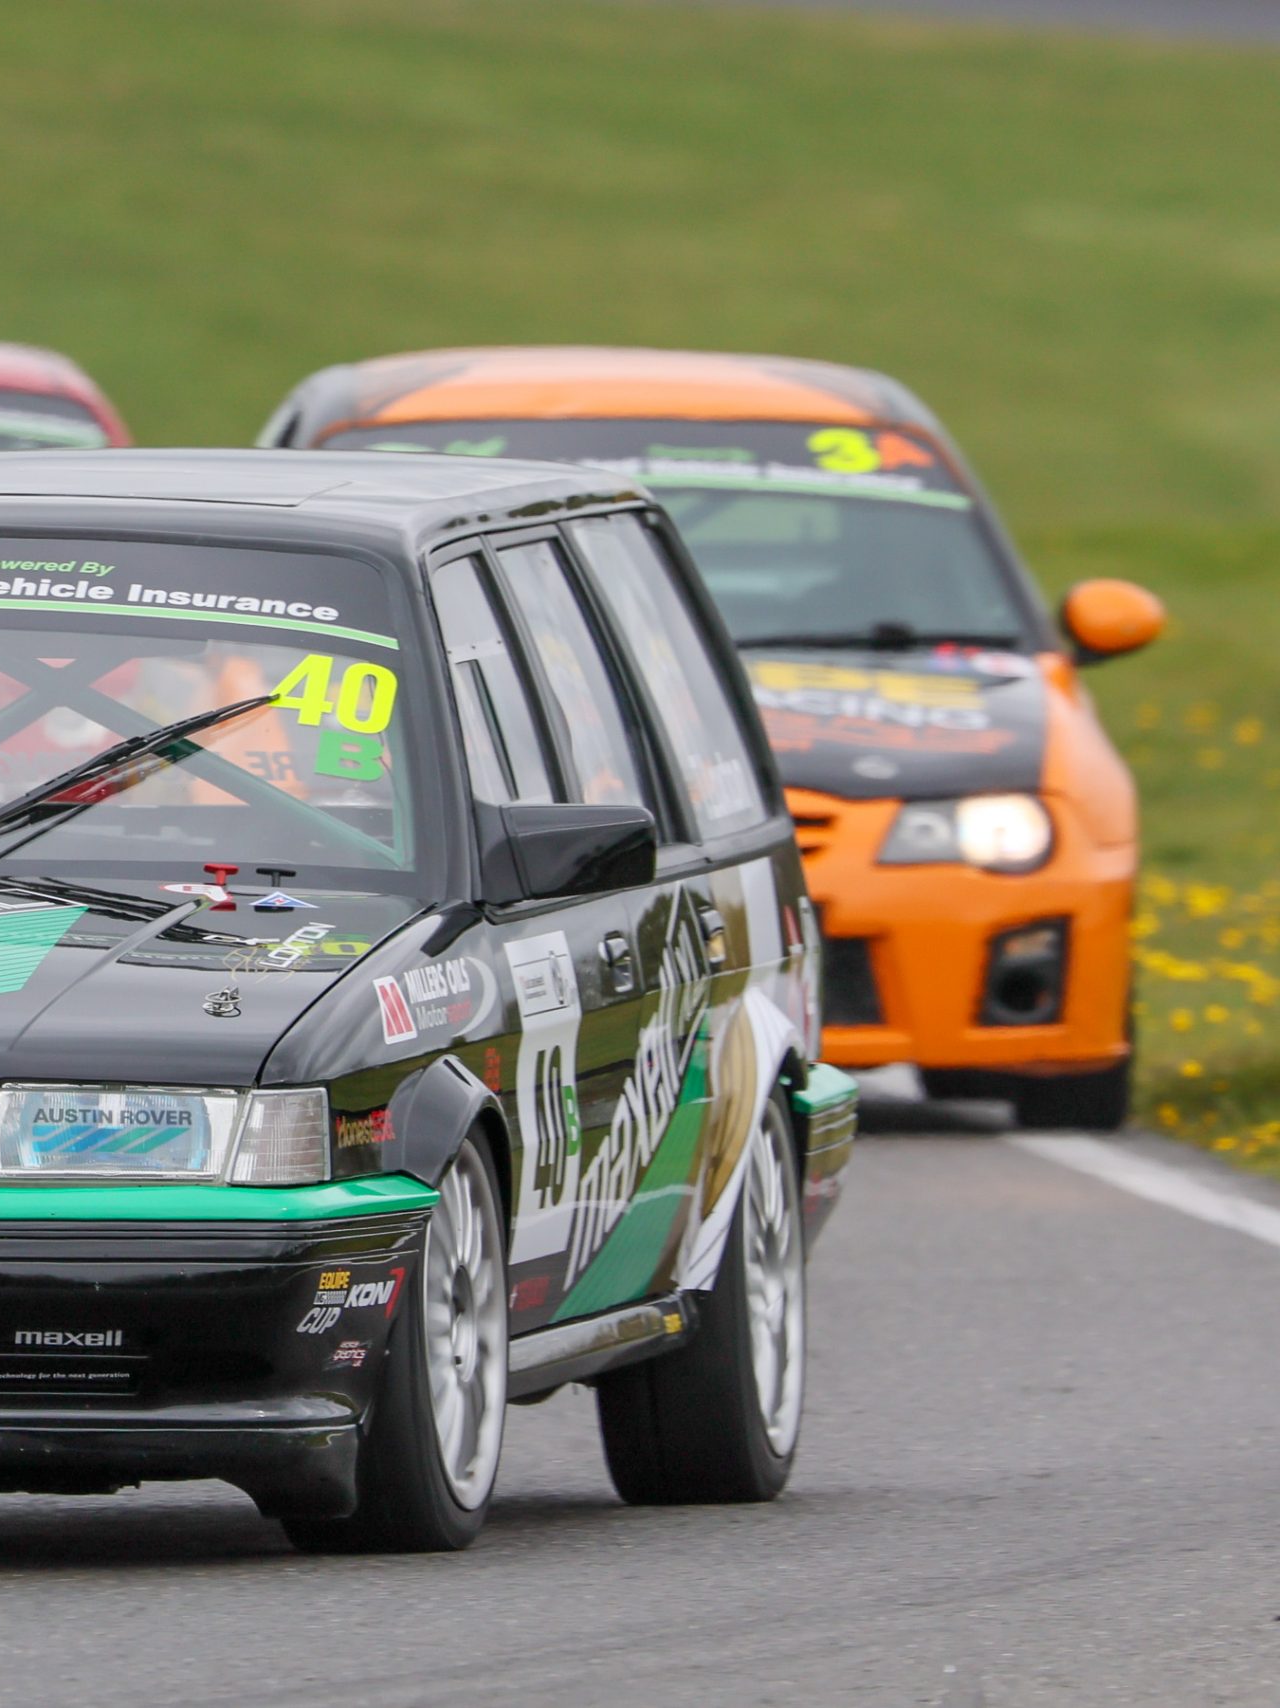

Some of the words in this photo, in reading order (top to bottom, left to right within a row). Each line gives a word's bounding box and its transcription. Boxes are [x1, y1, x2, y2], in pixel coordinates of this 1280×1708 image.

[79, 561, 115, 577] By
[128, 584, 340, 623] Insurance
[266, 654, 398, 734] 40
[315, 731, 385, 781] B
[404, 963, 448, 1004] MILLERS
[445, 957, 471, 995] OILS
[33, 1108, 112, 1125] AUSTIN
[121, 1109, 192, 1126] ROVER
[296, 1307, 342, 1334] CUP
[15, 1330, 123, 1346] maxell
[38, 1372, 51, 1380] for
[87, 1372, 131, 1380] generation
